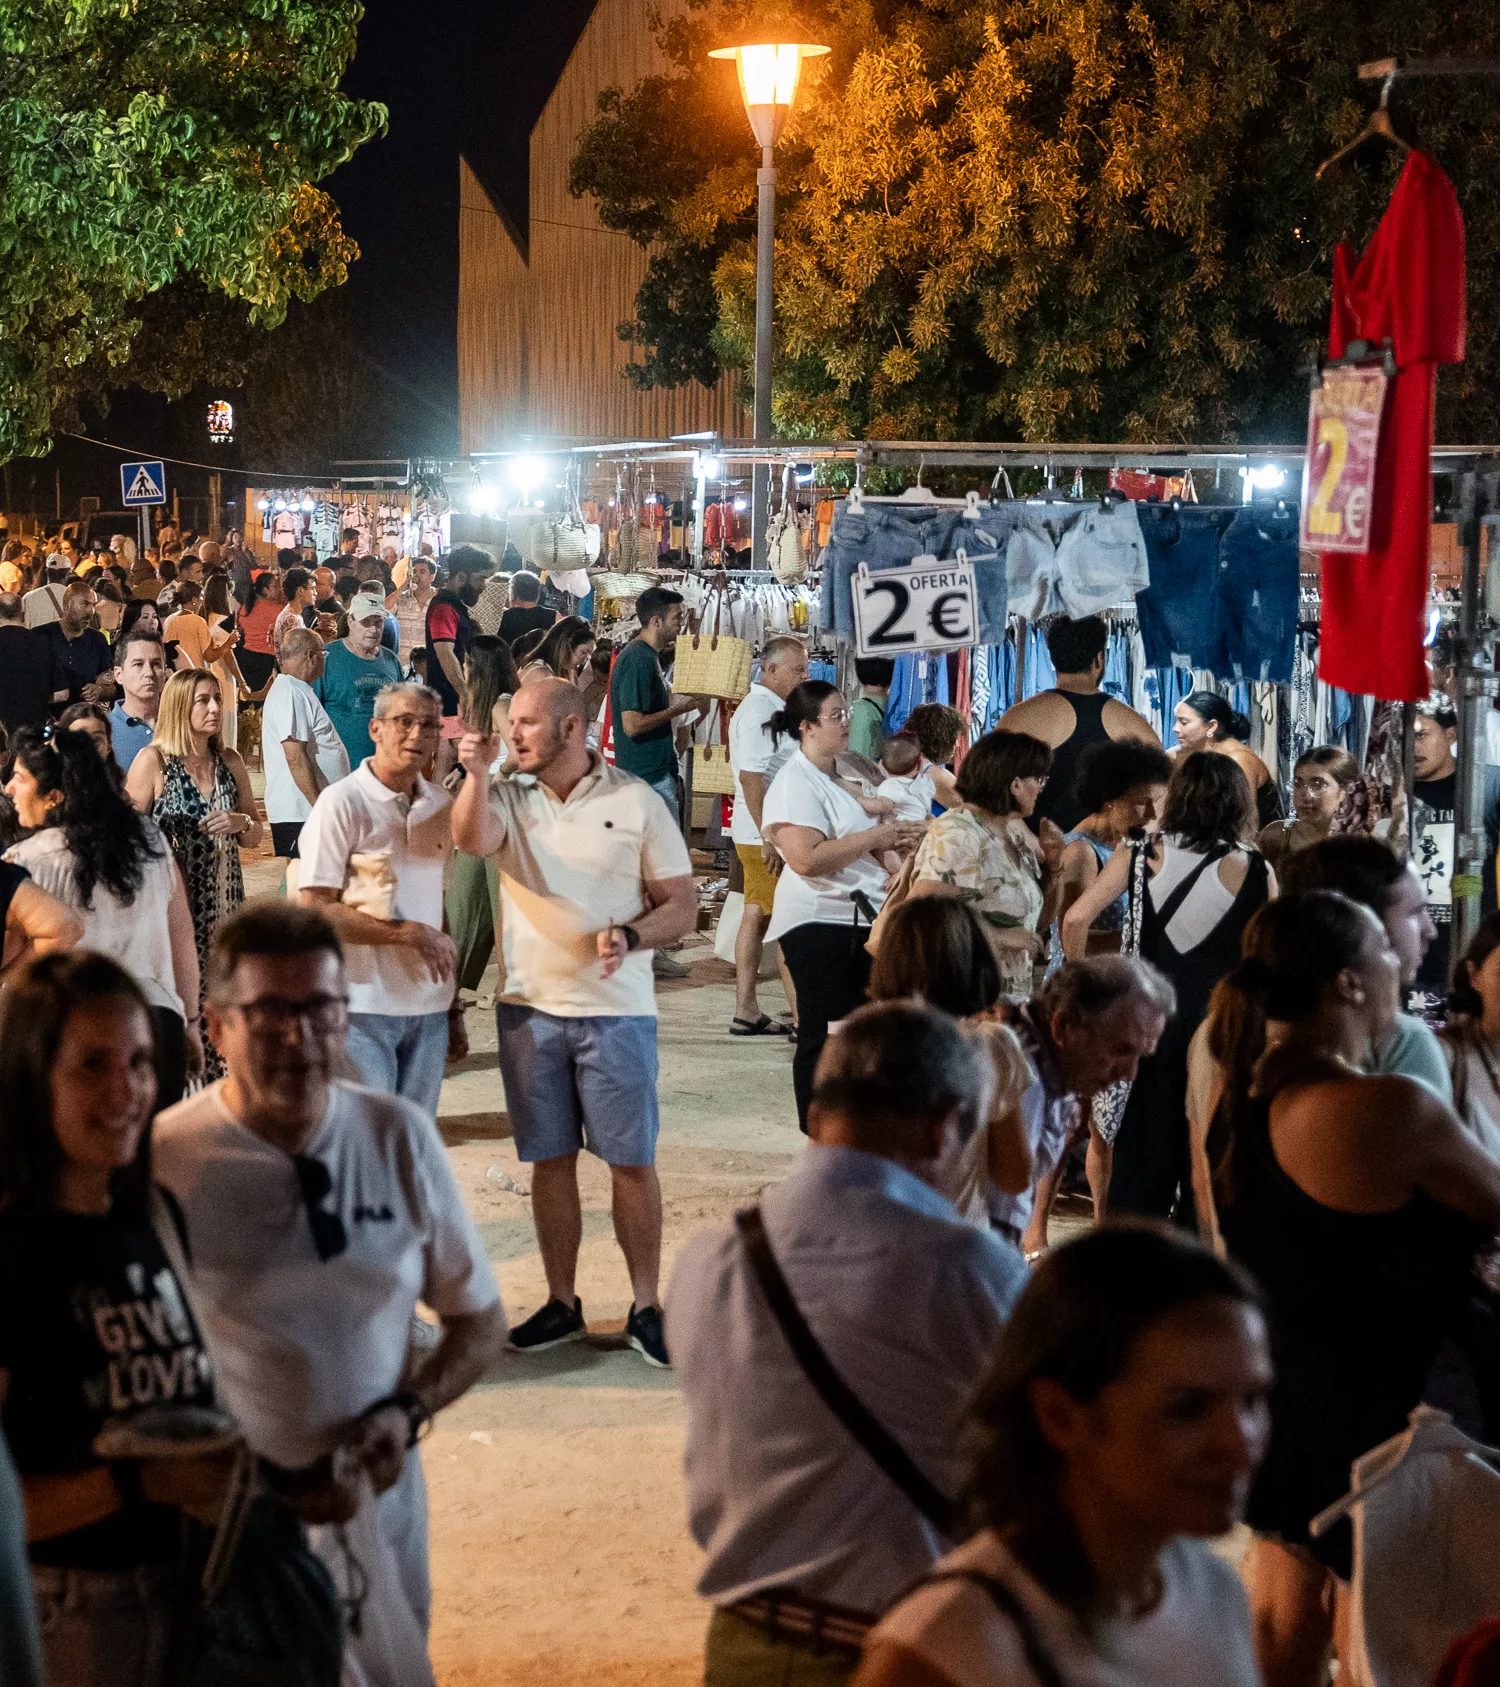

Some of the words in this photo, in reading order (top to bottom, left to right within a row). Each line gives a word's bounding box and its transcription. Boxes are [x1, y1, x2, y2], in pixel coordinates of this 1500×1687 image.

[1308, 418, 1349, 535] 2
[1345, 485, 1367, 538] €
[864, 580, 917, 647] 2
[927, 590, 970, 640] €
[909, 572, 970, 591] OFERTA
